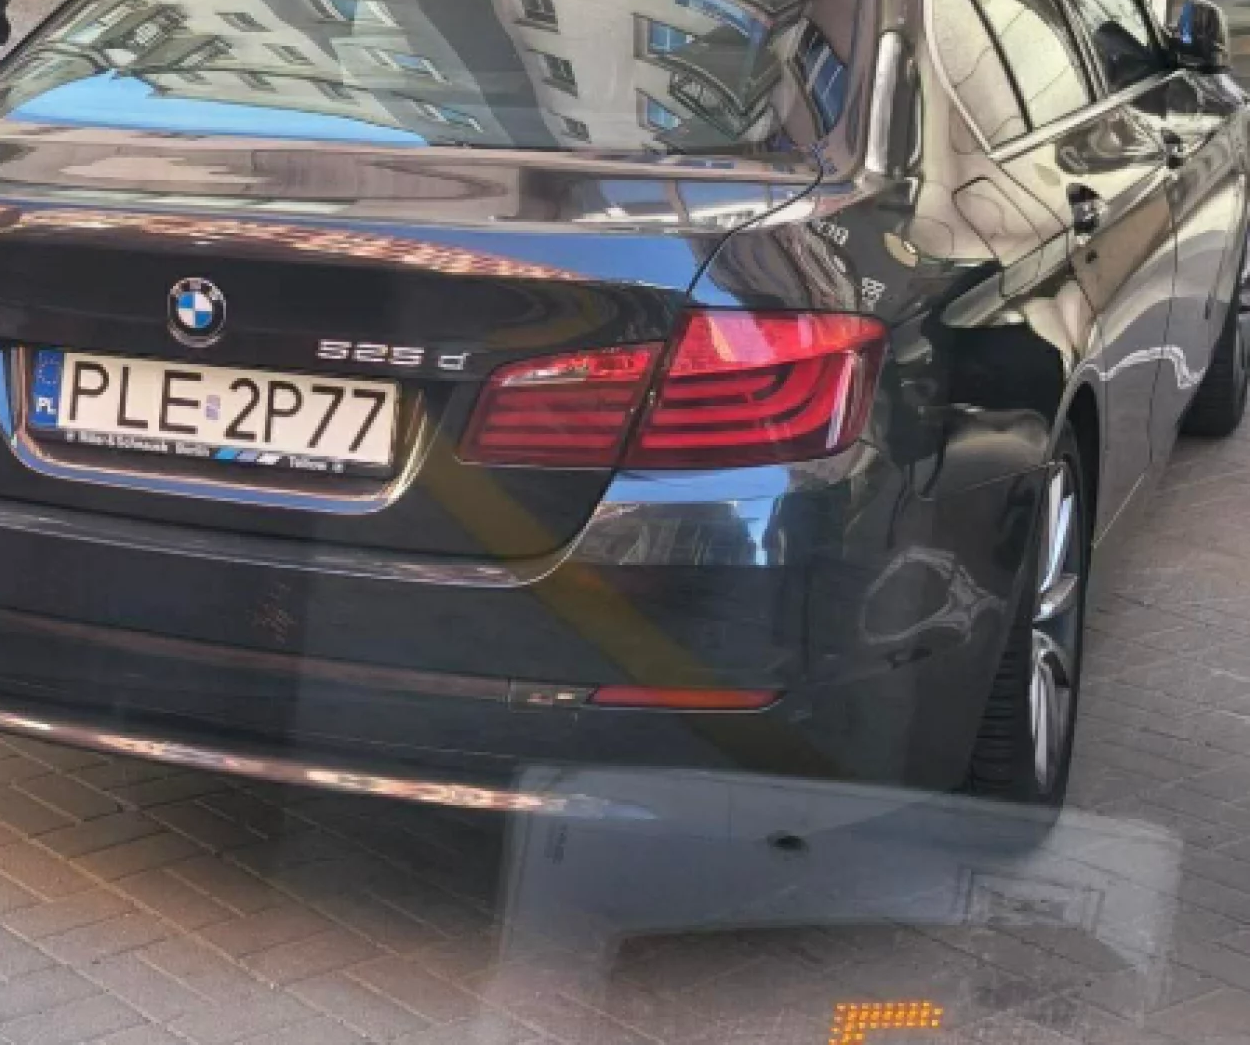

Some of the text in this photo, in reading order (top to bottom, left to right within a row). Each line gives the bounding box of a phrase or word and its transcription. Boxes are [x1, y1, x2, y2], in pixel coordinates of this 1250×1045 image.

[35, 396, 57, 415] PL
[68, 360, 388, 454] PLE 2P77
